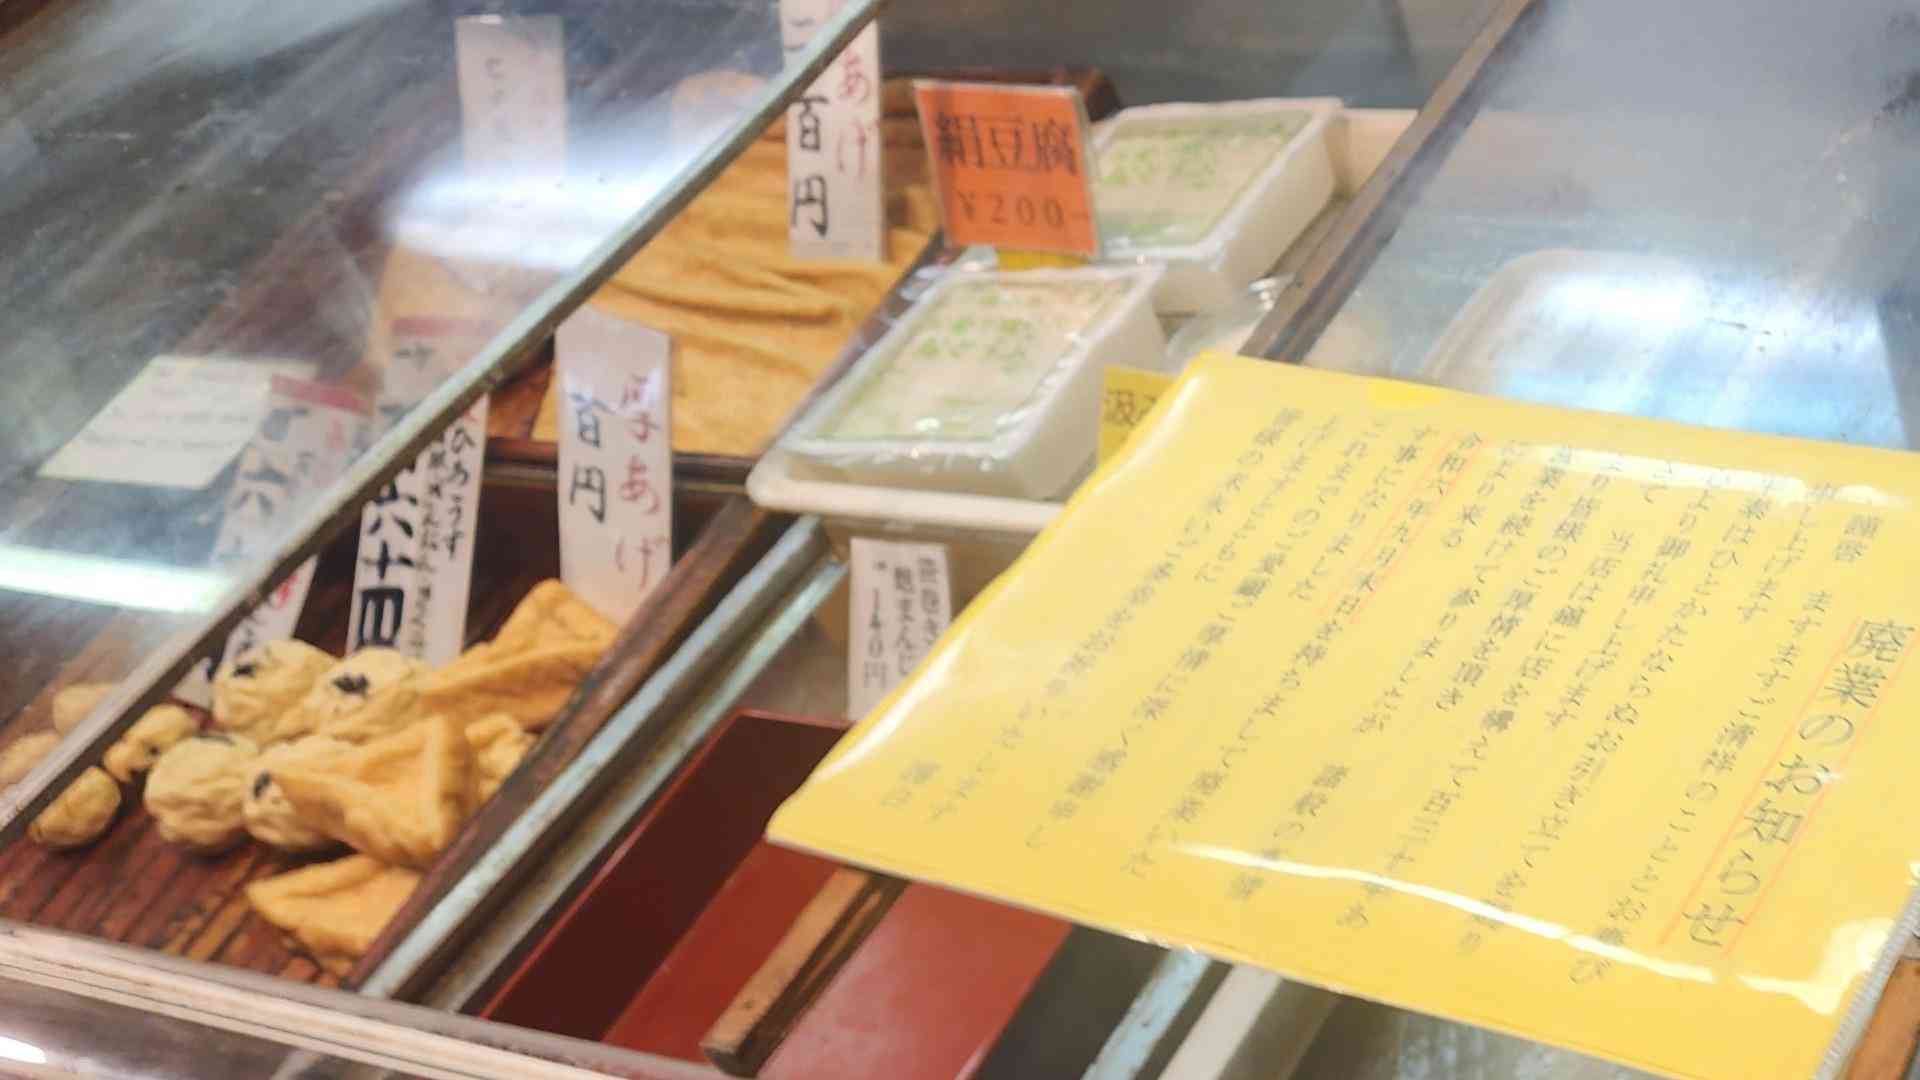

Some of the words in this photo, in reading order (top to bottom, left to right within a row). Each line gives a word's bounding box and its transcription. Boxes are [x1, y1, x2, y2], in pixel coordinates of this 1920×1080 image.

[934, 110, 1079, 178] 絹豆腐
[567, 391, 617, 524] 百円
[1688, 618, 1912, 949] 廃業のお知らせ
